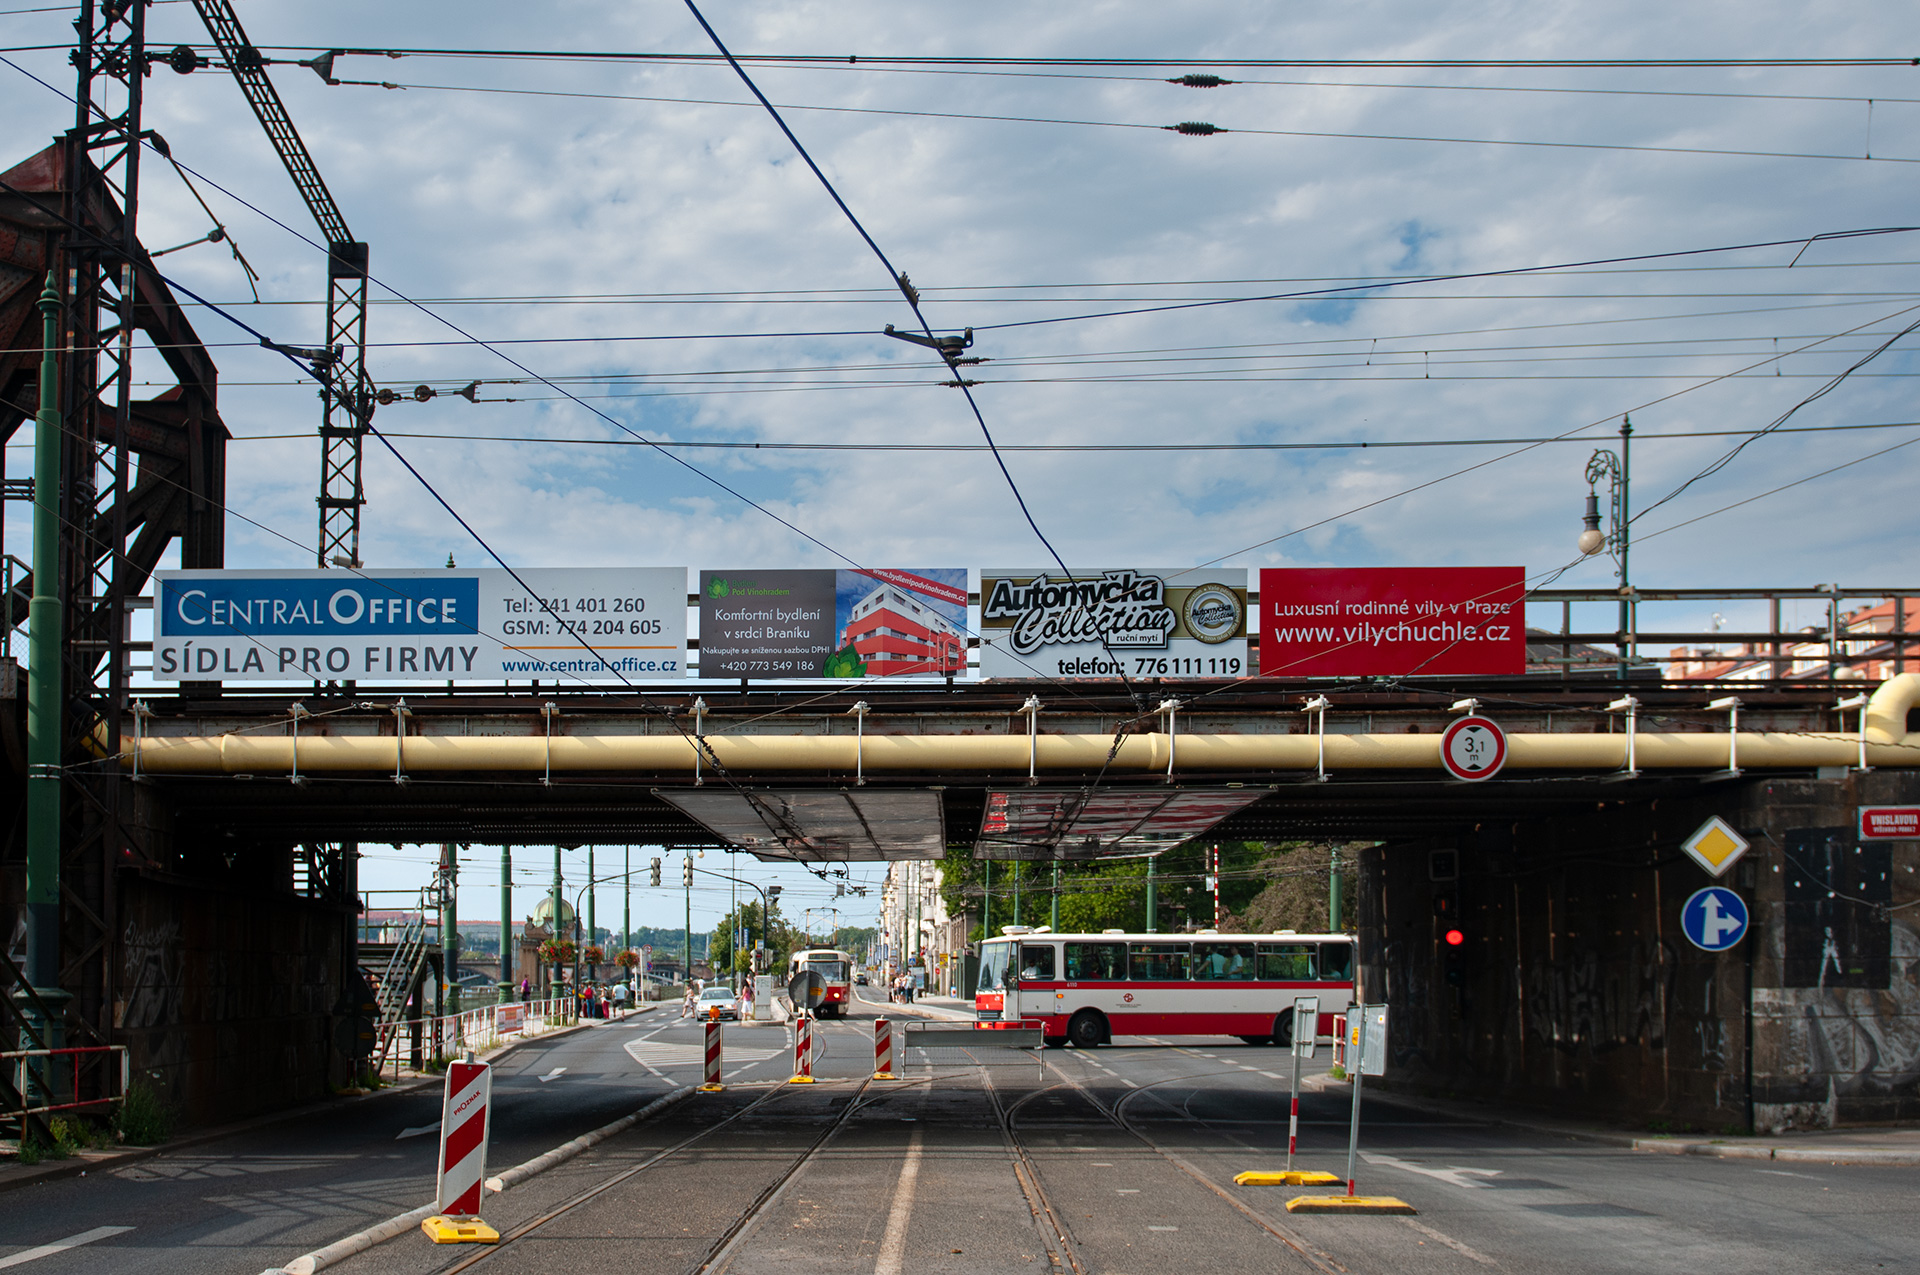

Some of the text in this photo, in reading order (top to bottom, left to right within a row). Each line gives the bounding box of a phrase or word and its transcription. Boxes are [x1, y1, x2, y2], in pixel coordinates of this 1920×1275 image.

[732, 588, 790, 596] Pod Vinohradem
[872, 568, 966, 602] www.bydlenipodvinohradem.cz
[987, 573, 1160, 613] Automyčka
[503, 598, 645, 613] Tel: 241 401 260
[1274, 599, 1510, 618] Luxusní rodinné vily v Praze
[715, 607, 821, 624] Komfortní bydlení
[502, 620, 662, 635] GSM: 774 204 605
[723, 626, 810, 639] v srdci Braníku
[1013, 605, 1172, 650] Collection
[1274, 620, 1511, 647] www.vilychuchle.cz
[1116, 633, 1158, 644] ruční mytí
[160, 641, 479, 673] SÍDLA PRO FIRMY
[702, 647, 740, 656] Nakupujte
[751, 646, 782, 654] sníženou
[784, 646, 810, 654] sazbou
[811, 646, 830, 654] DPH!
[502, 657, 677, 672] www.central-office.cz
[720, 661, 815, 671] +420 773 549 186
[1057, 657, 1241, 675] telefon: 776 111 119
[1870, 815, 1919, 825] VNISLAVOVA
